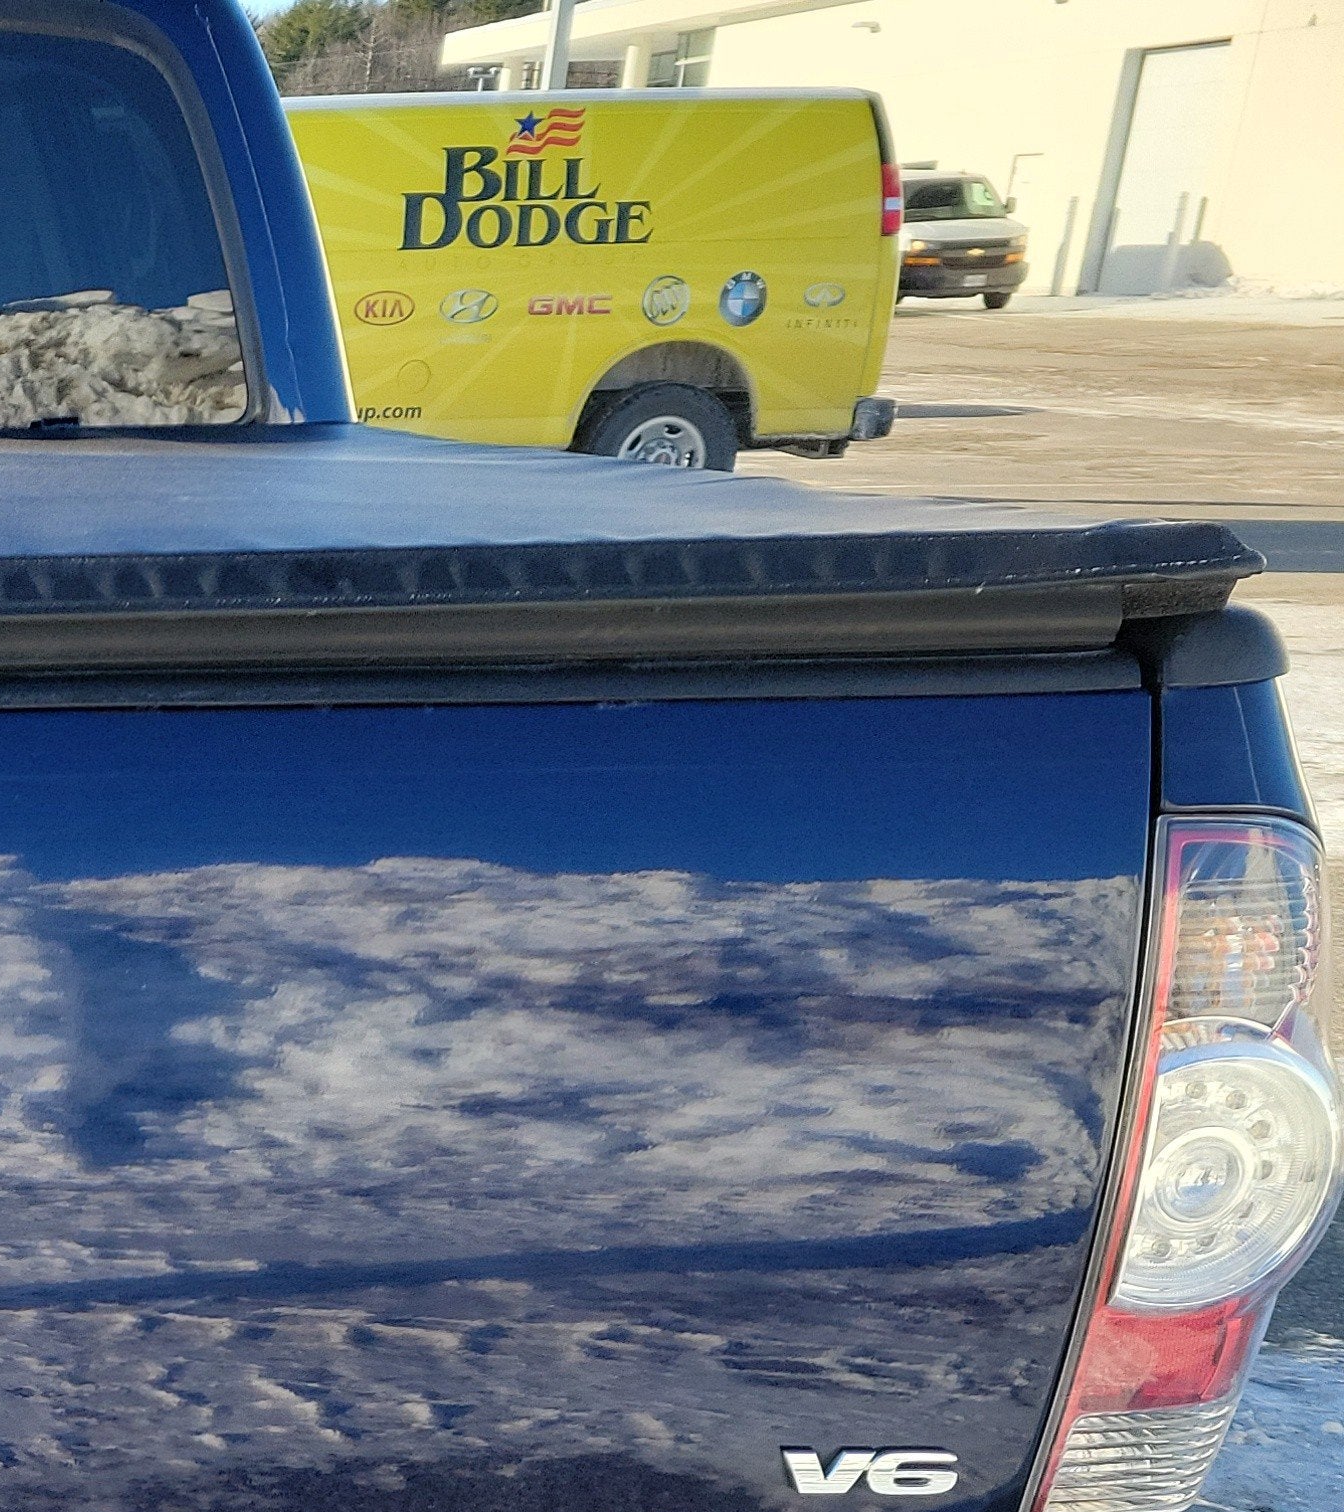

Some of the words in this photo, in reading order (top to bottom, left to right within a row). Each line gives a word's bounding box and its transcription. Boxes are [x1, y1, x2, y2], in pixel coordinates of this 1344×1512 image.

[443, 146, 600, 202] BILL
[397, 192, 653, 250] DODGE
[364, 299, 404, 318] KIA
[527, 295, 613, 316] GMC
[782, 1448, 959, 1496] V6
